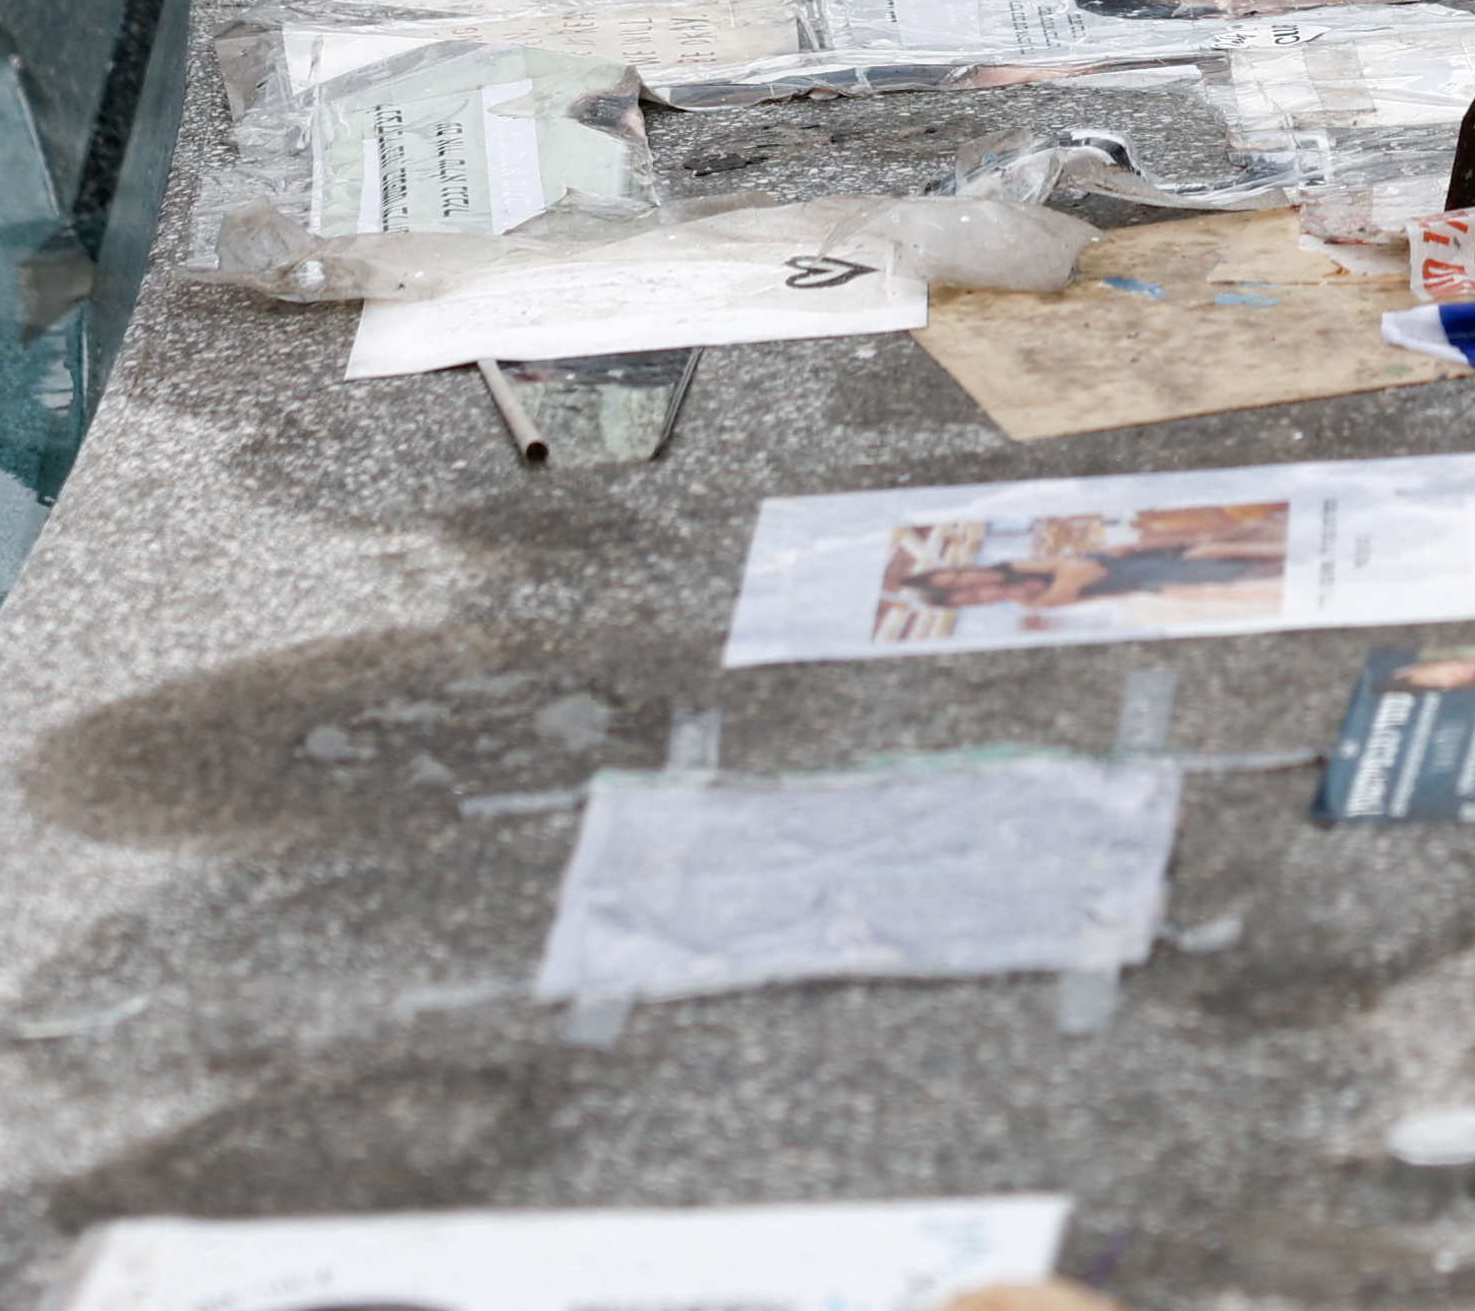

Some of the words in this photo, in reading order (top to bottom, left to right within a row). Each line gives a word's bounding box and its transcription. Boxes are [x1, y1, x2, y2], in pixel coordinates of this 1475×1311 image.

[549, 11, 598, 37] REA
[617, 17, 654, 46] WILL
[621, 50, 662, 66] WE
[436, 122, 464, 136] עם
[436, 138, 464, 157] אור
[429, 158, 467, 183] שלא
[440, 185, 470, 218] נגמר
